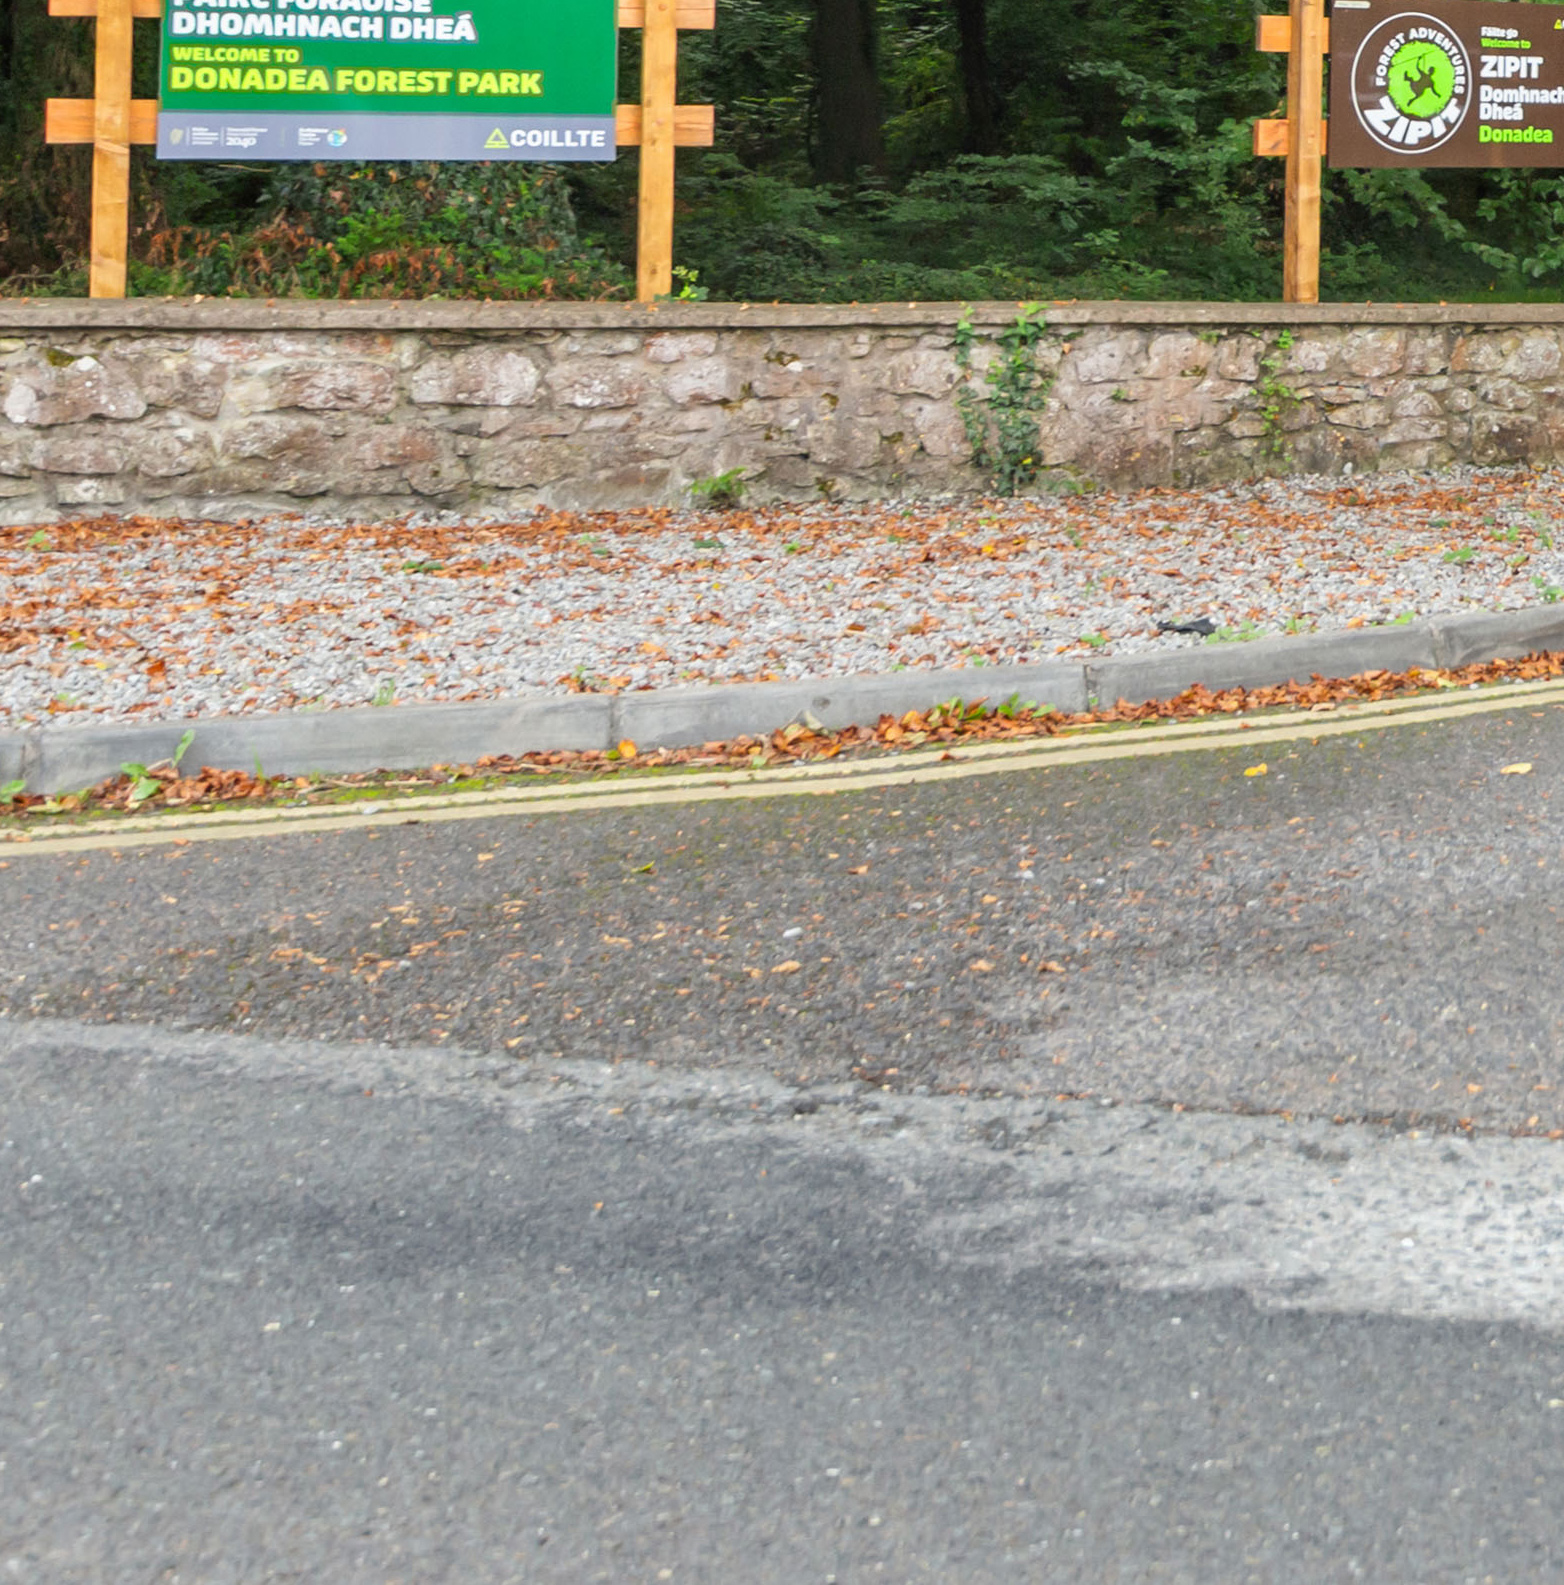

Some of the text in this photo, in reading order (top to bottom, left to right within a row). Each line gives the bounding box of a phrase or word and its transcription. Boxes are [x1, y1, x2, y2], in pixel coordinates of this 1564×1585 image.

[172, 11, 476, 41] DHOMHNACH DHEÁ
[1506, 27, 1519, 40] go
[1480, 38, 1532, 50] Welcome to
[172, 47, 299, 62] WELCOME TO
[1375, 27, 1466, 95] FOREST ADVENTURES
[1480, 55, 1544, 79] ZIPIT
[171, 67, 541, 95] DONADEA FOREST PARK
[1363, 95, 1462, 145] ZIPIT
[1479, 102, 1524, 121] Dheá
[510, 129, 606, 147] COILLTE
[1479, 124, 1553, 144] Donadea
